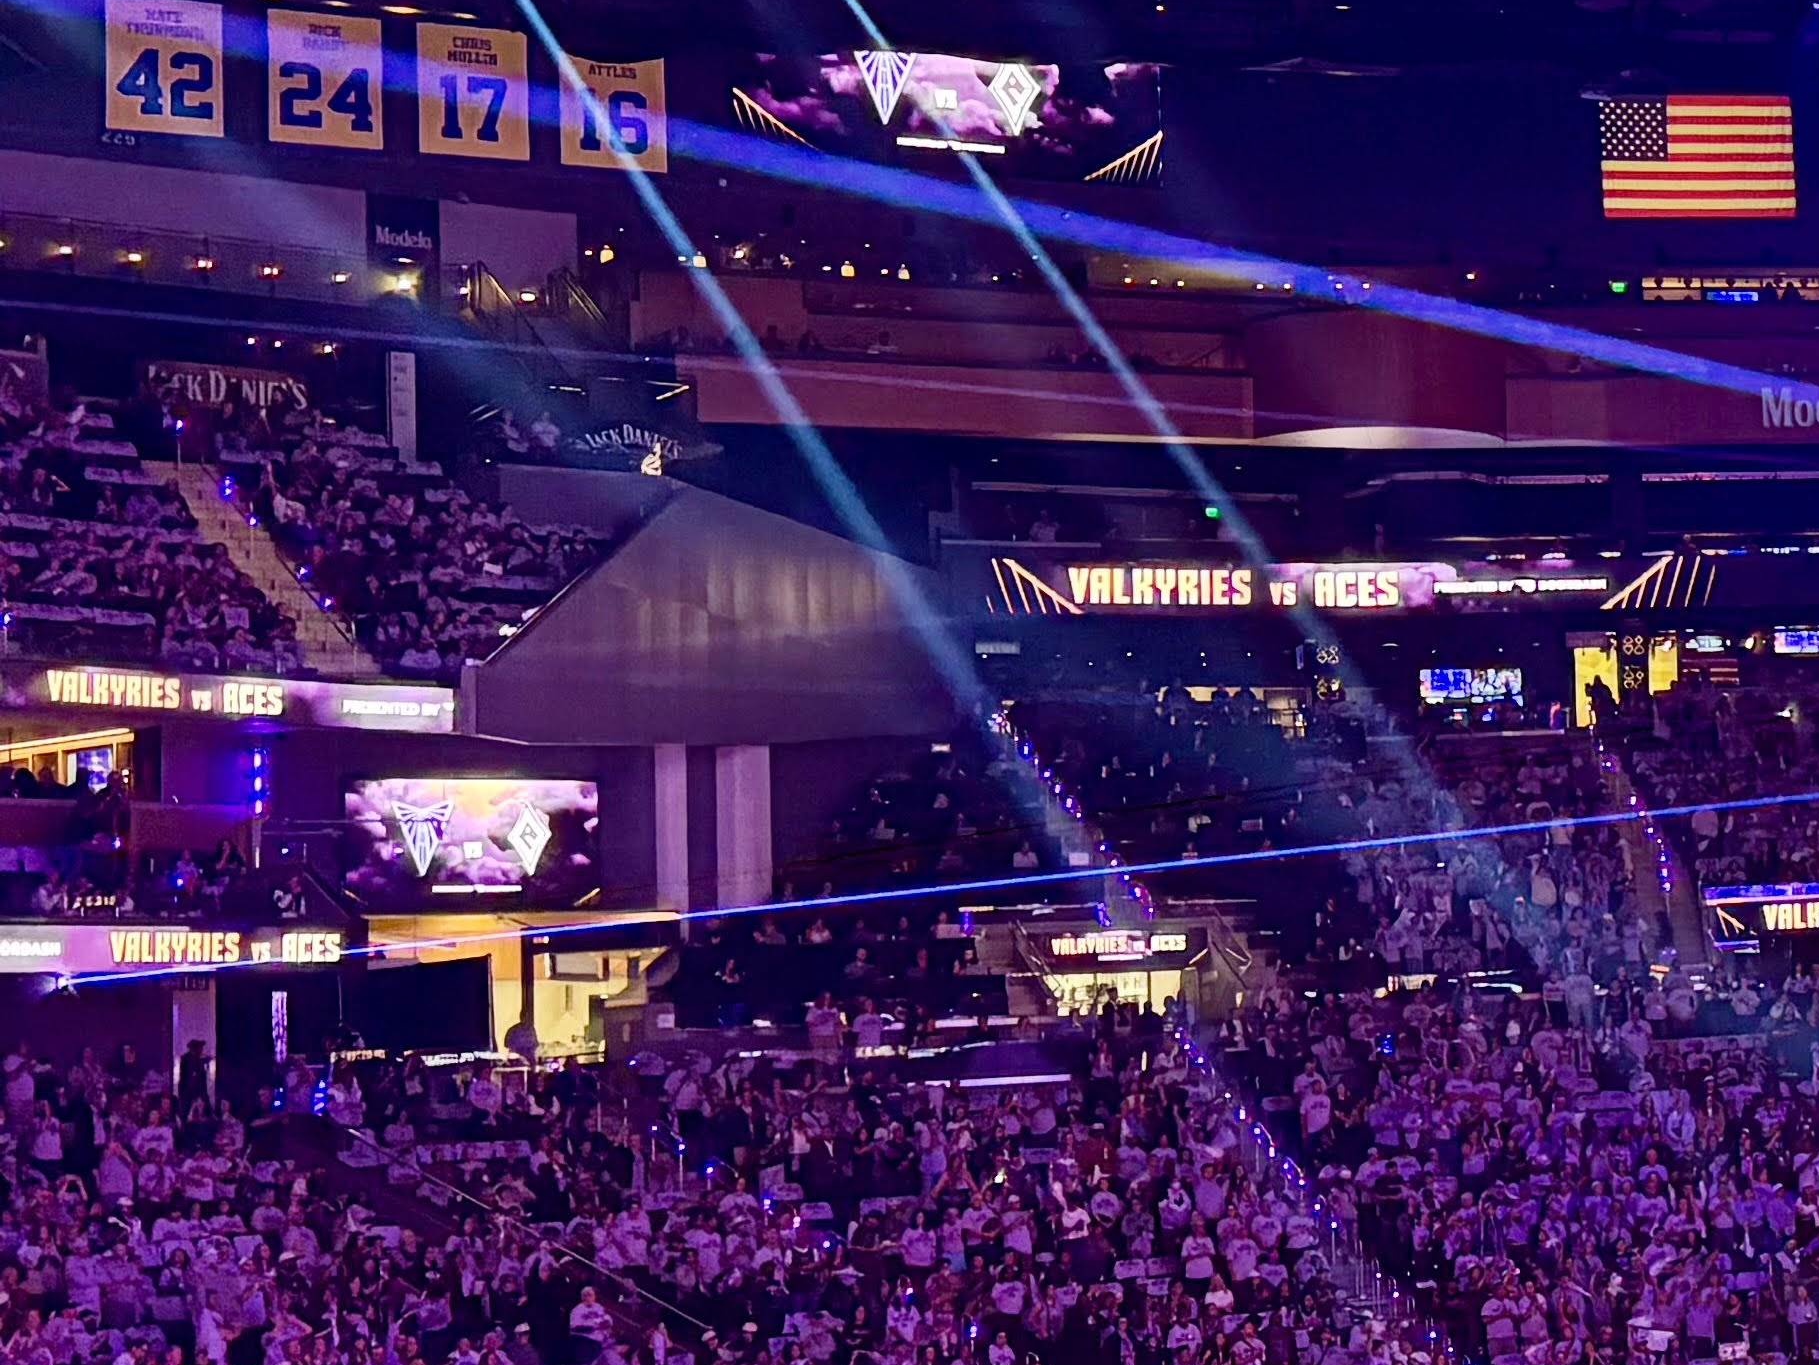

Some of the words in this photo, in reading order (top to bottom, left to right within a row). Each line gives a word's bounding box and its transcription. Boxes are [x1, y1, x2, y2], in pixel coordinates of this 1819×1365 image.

[116, 47, 214, 120] 42
[279, 61, 373, 133] 24
[440, 74, 508, 143] 17
[579, 89, 650, 156] 16
[376, 224, 433, 250] Modelo
[1067, 567, 1253, 606] VALKYRIES
[1269, 581, 1298, 605] VS
[1313, 570, 1401, 608] ACES
[47, 669, 181, 710] VALKYRIES
[223, 680, 285, 716] ACES
[111, 930, 241, 964] VALKYRIES
[282, 931, 341, 964] ACES
